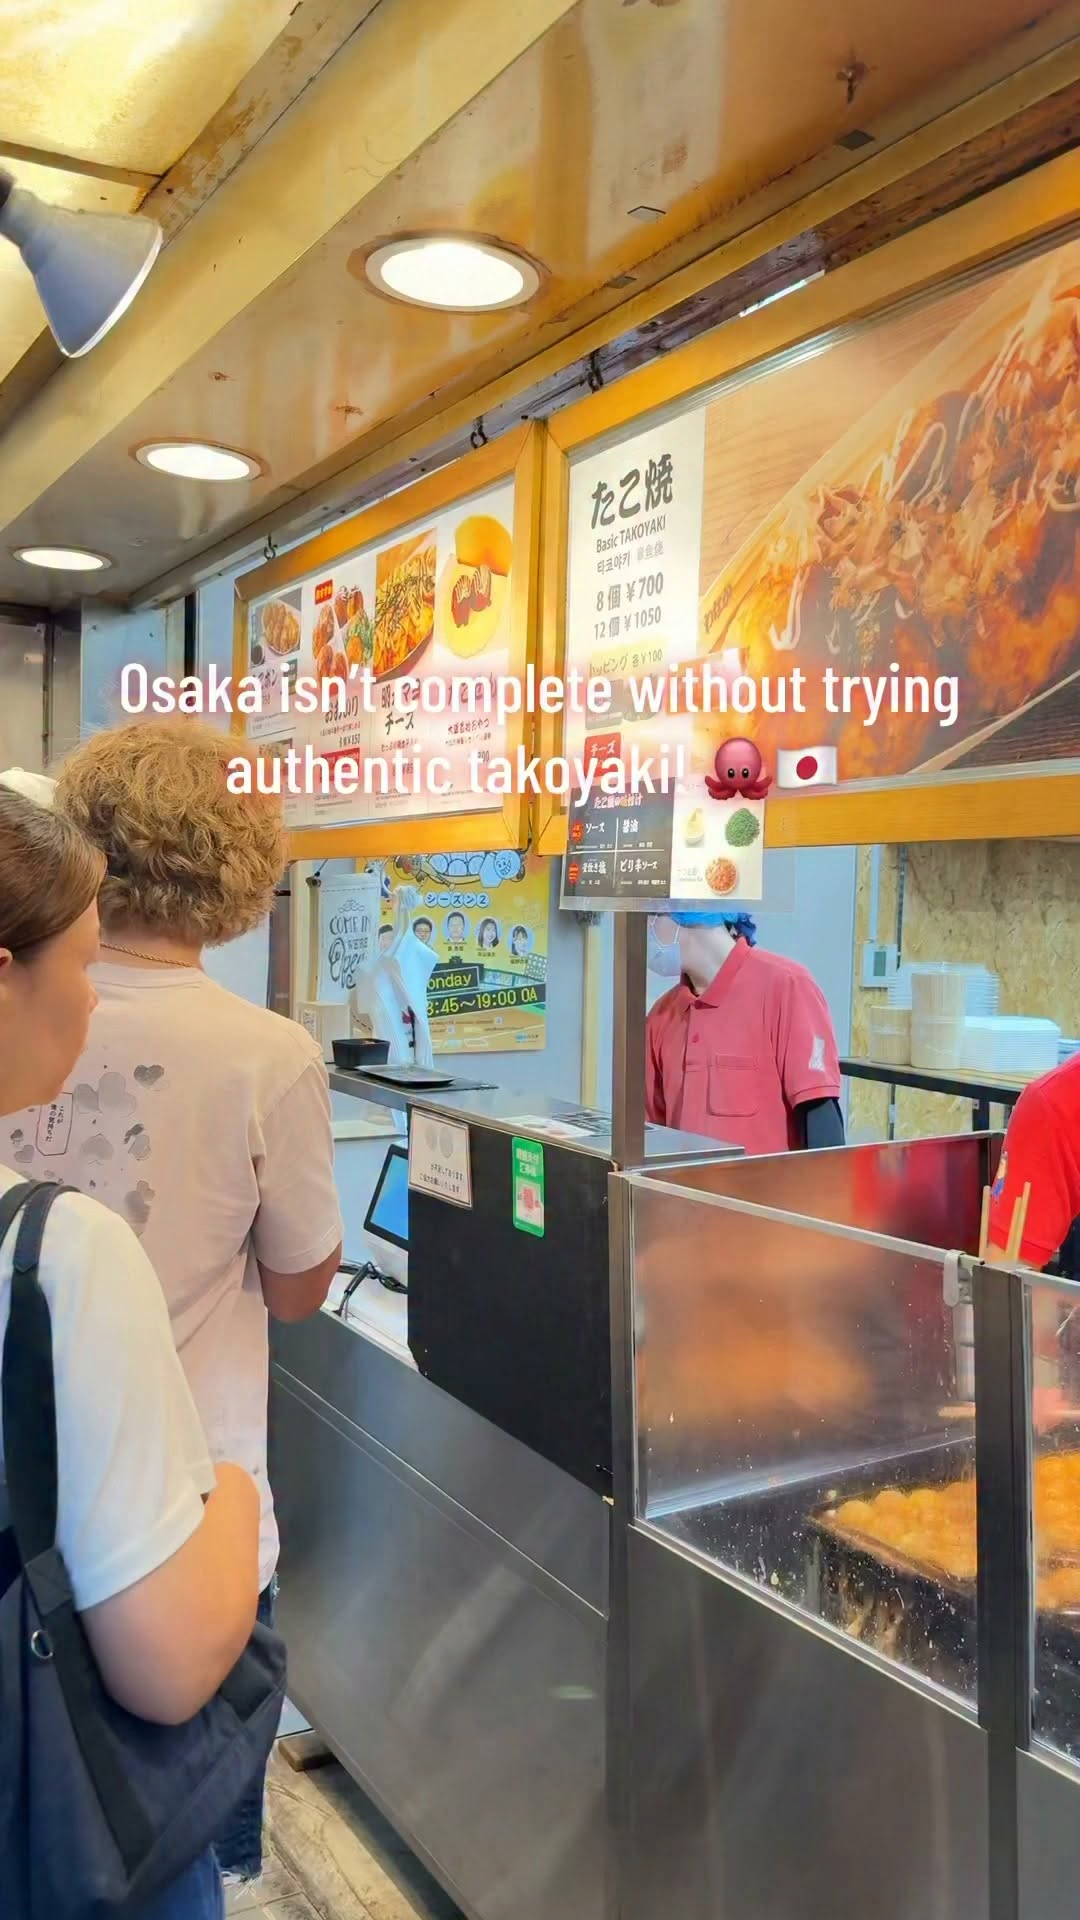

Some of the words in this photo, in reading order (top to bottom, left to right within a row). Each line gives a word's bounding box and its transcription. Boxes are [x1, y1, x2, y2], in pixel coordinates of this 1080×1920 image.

[591, 453, 673, 529] たこ焼
[596, 533, 618, 553] Basic
[620, 514, 666, 545] TAKOYAKI
[597, 549, 630, 575] 타코야키
[585, 822, 605, 833] ソース
[426, 893, 488, 907] シーズン2
[329, 915, 358, 935] COME
[428, 973, 471, 990] onday
[521, 986, 538, 1003] OA
